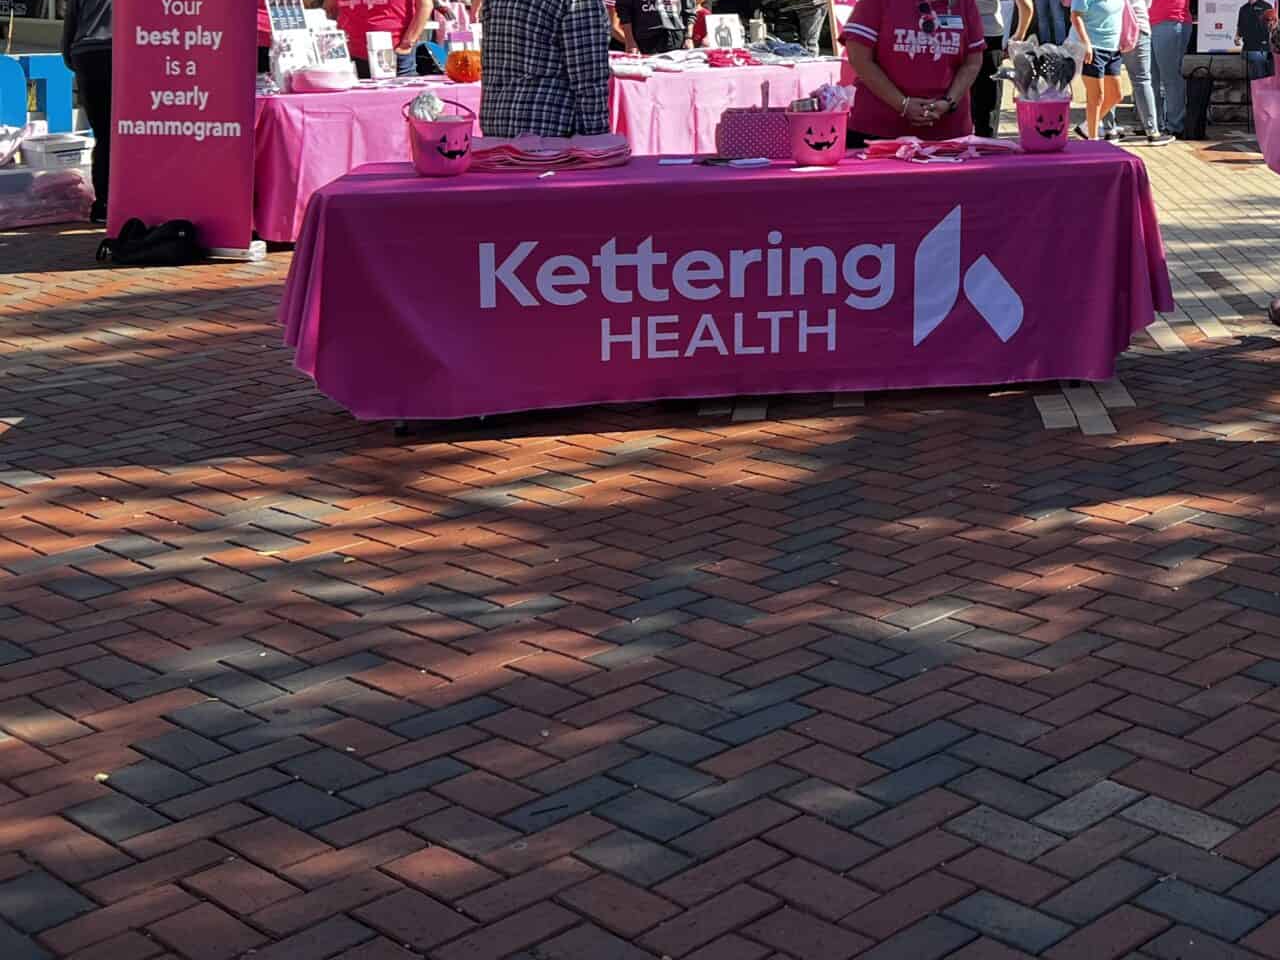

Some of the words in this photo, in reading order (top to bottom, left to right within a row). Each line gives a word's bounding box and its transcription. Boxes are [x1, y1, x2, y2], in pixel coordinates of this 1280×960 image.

[136, 25, 180, 45] best
[184, 25, 223, 50] play
[165, 56, 181, 75] is
[185, 60, 197, 75] a
[151, 86, 209, 110] yearly
[118, 119, 241, 141] mammogram
[478, 230, 896, 311] Kettering
[600, 308, 837, 361] HEALTH
